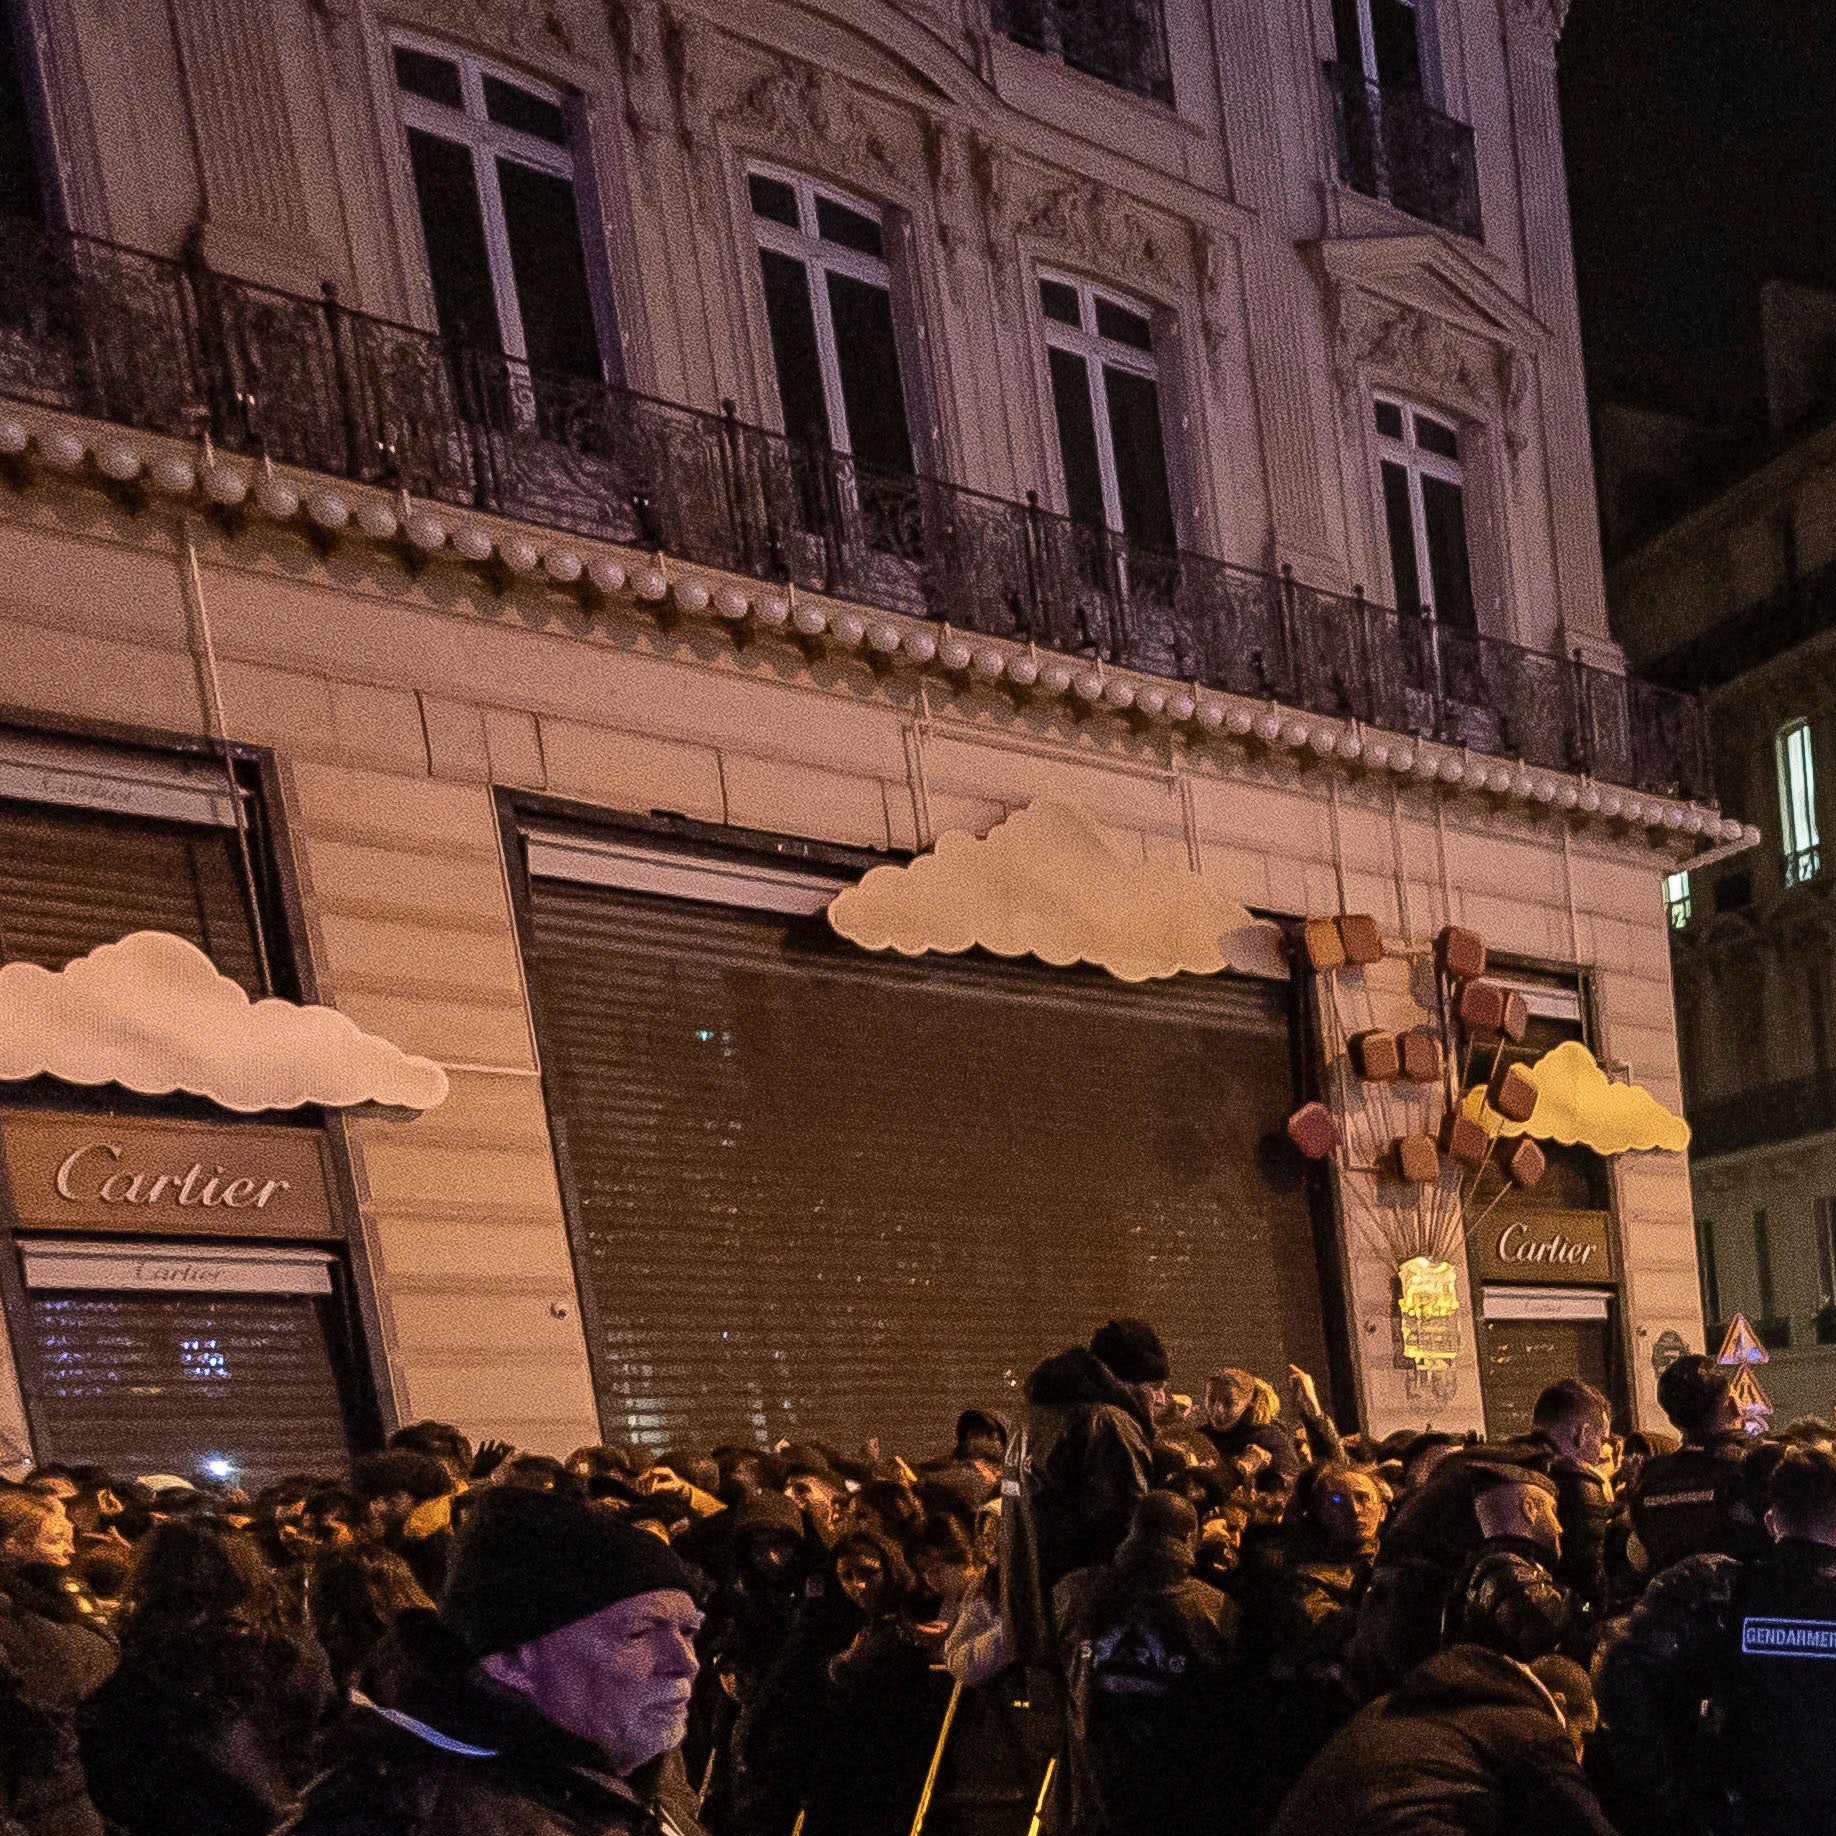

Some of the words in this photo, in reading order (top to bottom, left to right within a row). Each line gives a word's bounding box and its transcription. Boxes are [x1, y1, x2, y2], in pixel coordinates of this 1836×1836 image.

[56, 1142, 291, 1208] Cartier
[1499, 1222, 1598, 1266] Cartier
[133, 1261, 226, 1284] Cartier
